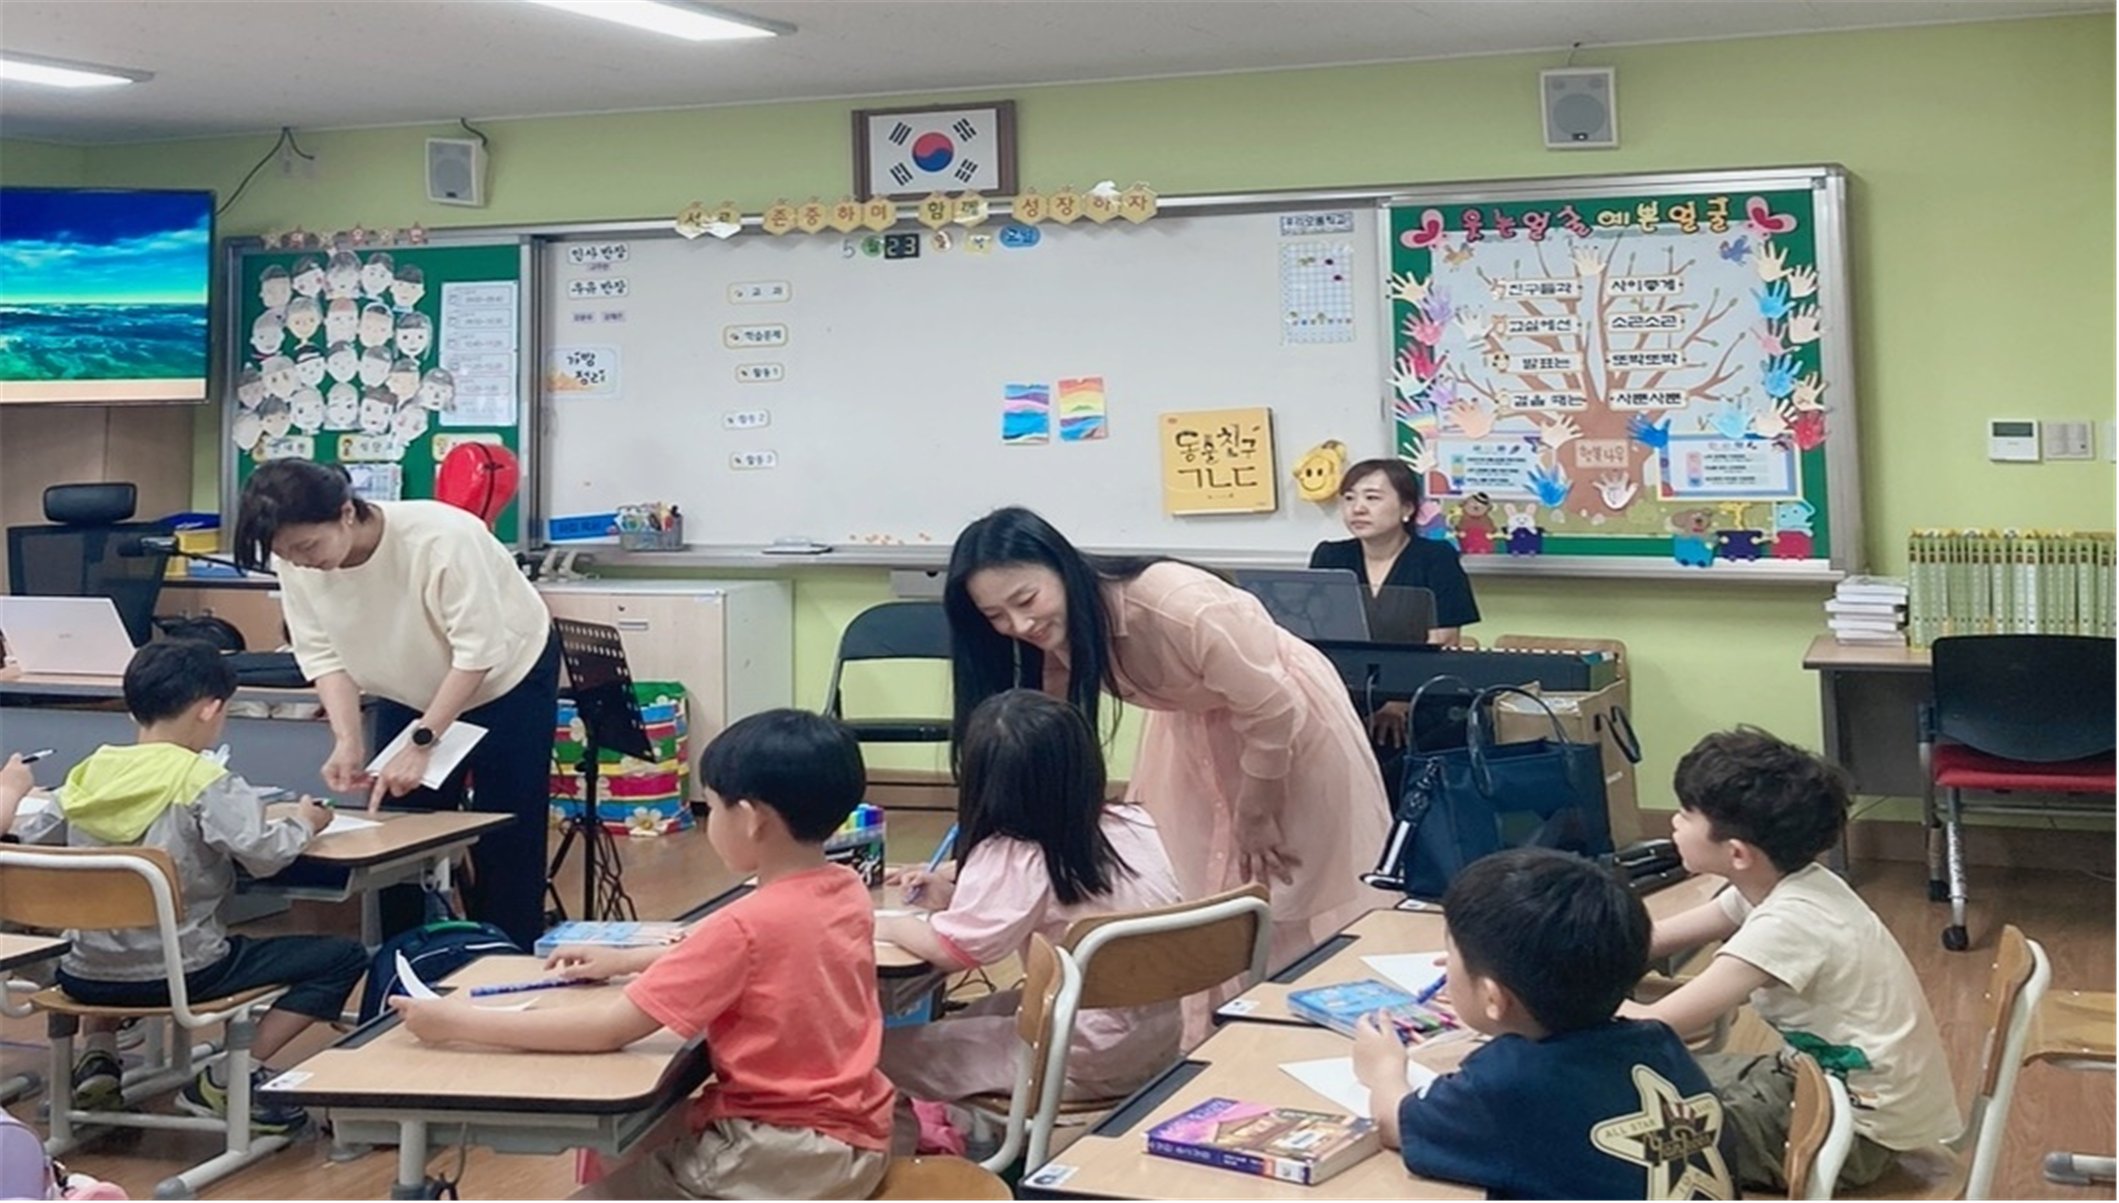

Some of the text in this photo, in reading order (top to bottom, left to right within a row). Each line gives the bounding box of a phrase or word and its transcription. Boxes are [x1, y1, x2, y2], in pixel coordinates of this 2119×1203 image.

[771, 205, 886, 226] 존중하며
[1022, 195, 1148, 217] 성장하자
[571, 244, 627, 262] 인사 반장
[842, 239, 856, 258] 5
[886, 237, 917, 257] 23
[571, 279, 627, 295] 우유 반장
[1508, 279, 1676, 296] 친구들과 사이좋게
[1509, 315, 1677, 333] 교실에선 소곤소곤
[566, 351, 596, 368] 가방
[1522, 353, 1678, 370] 발표는 또박또박
[575, 369, 606, 386] 정리
[1616, 392, 1681, 406] 사뿐사뿐
[1177, 466, 1259, 489] ㄱㄴㄷ
[1605, 1118, 1658, 1138] ALL STAR
